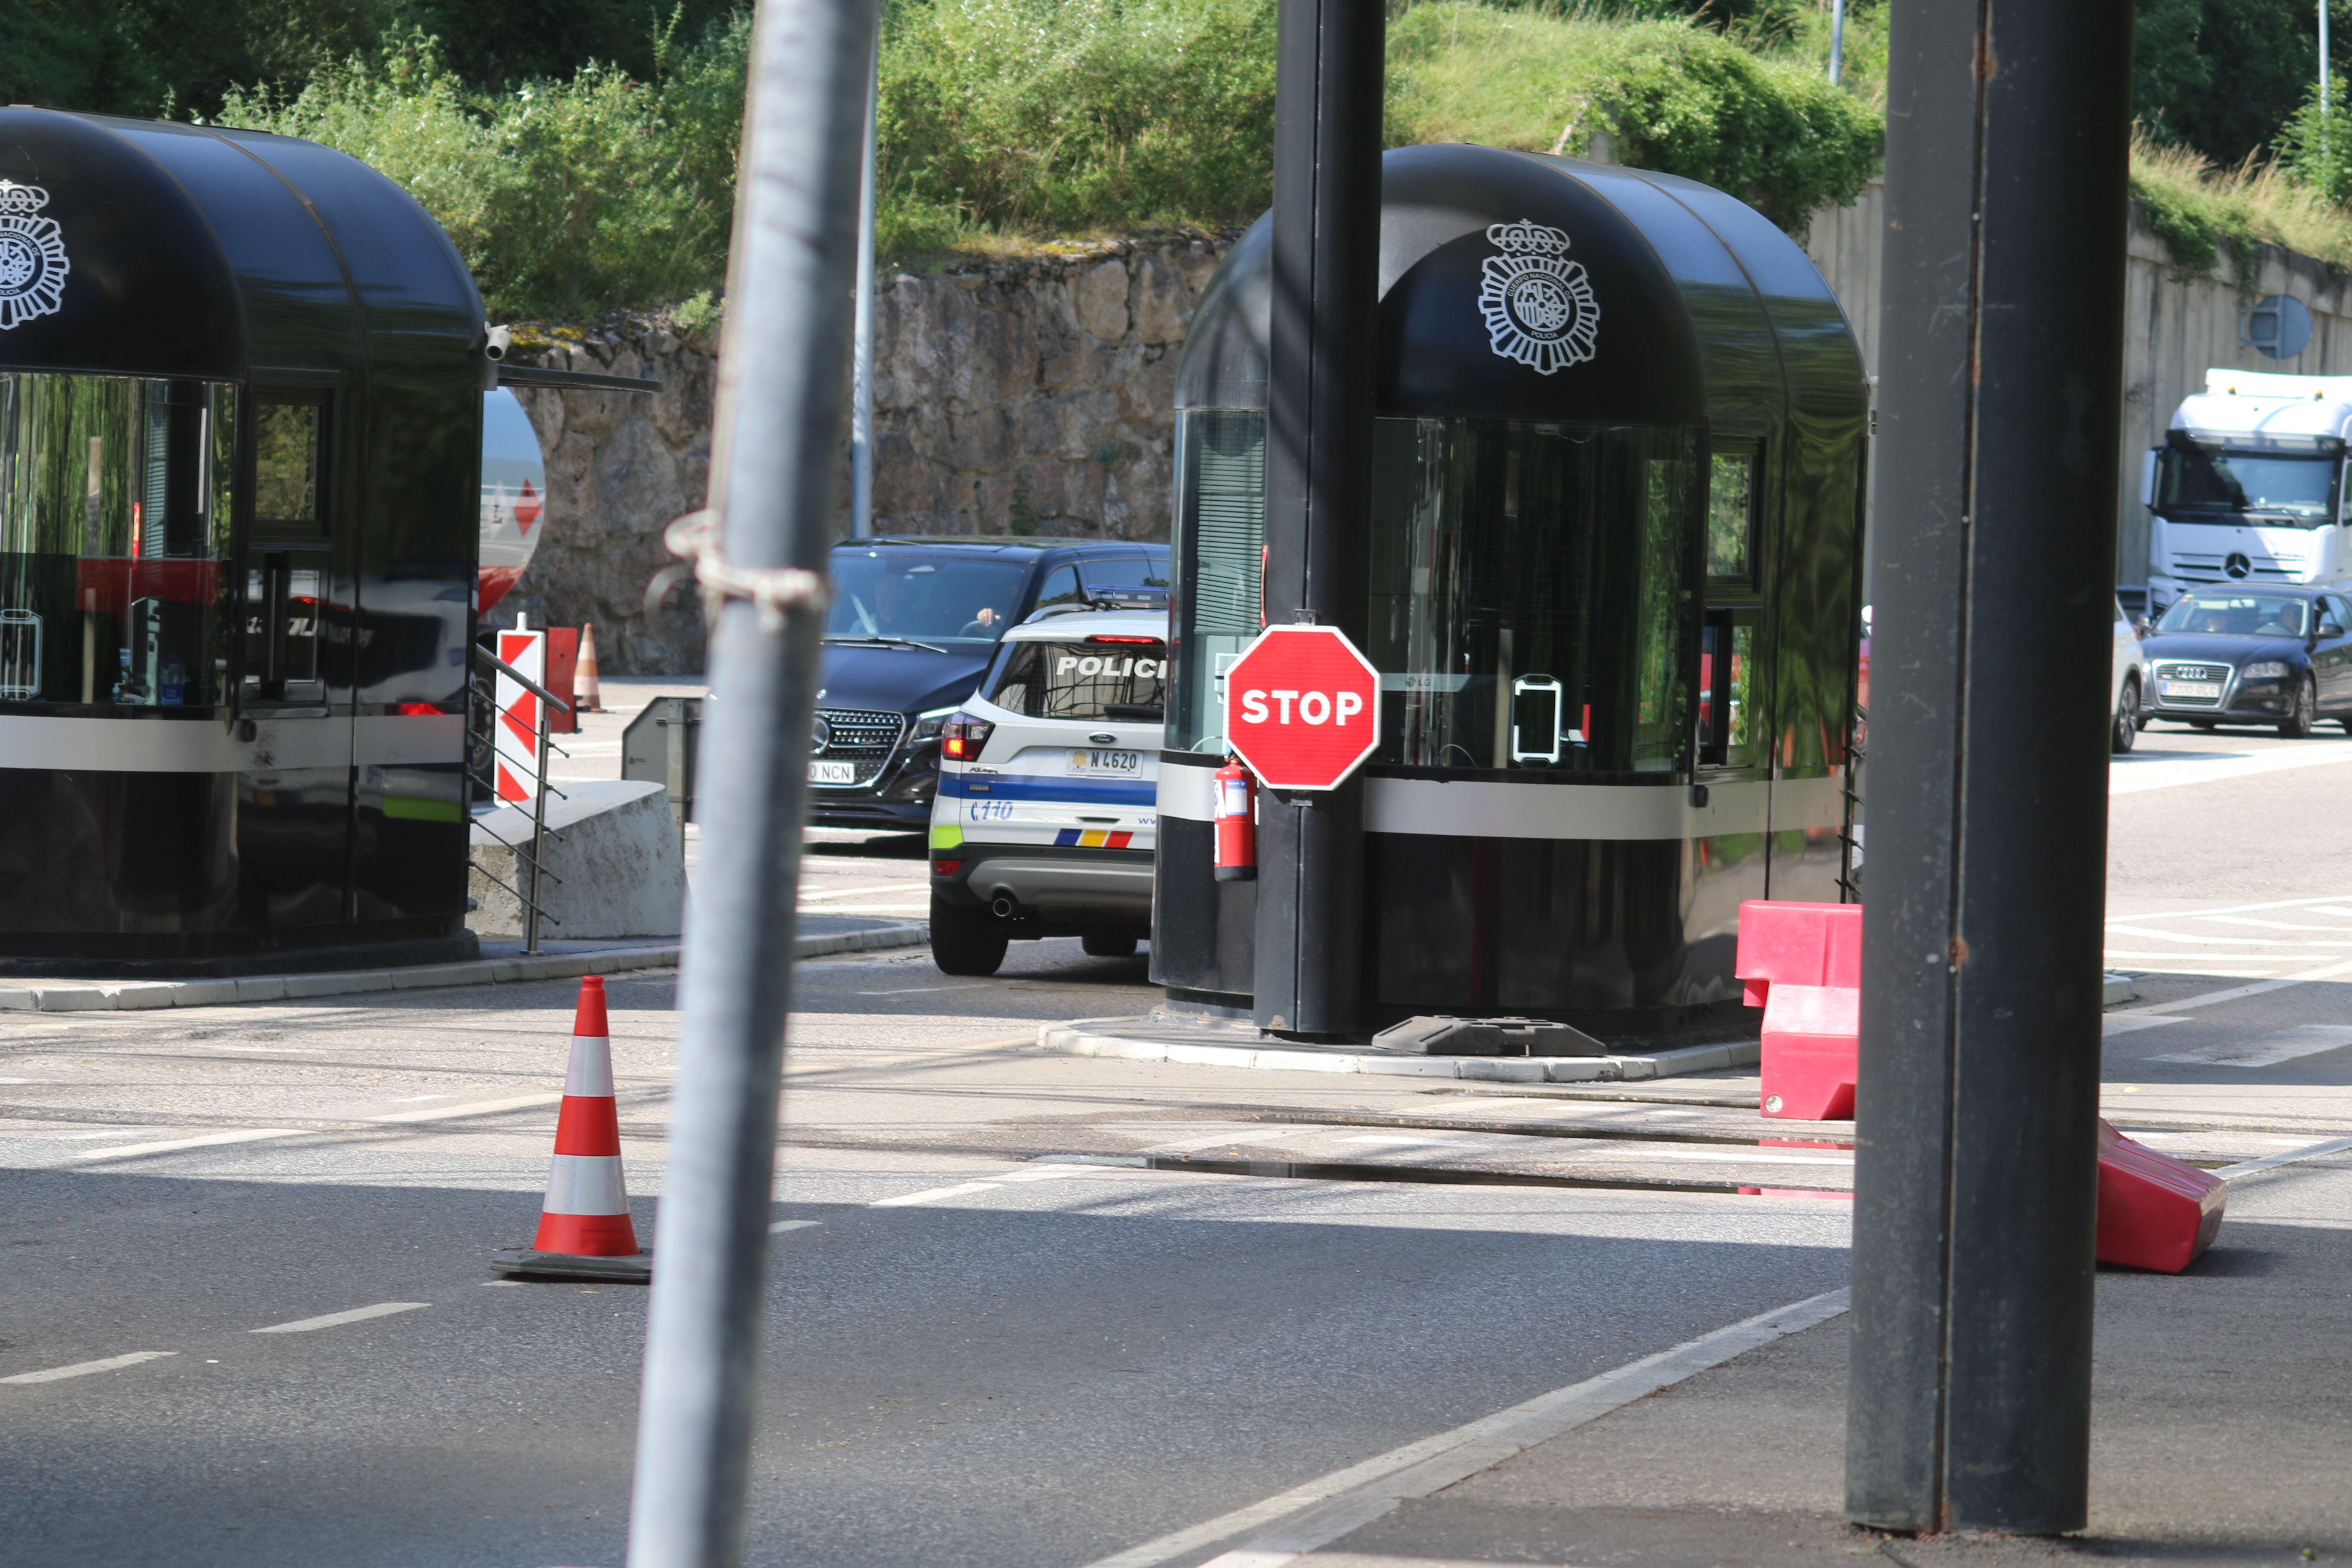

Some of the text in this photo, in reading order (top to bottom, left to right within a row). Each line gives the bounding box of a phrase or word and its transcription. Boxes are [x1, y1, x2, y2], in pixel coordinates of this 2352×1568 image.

[31, 247, 41, 257] DE
[1507, 273, 1573, 300] CUERPO NACIONAL DE
[2170, 684, 2193, 694] 7200
[1240, 689, 1363, 726] STOP
[1091, 752, 1137, 769] N 4620
[822, 766, 850, 779] NCN
[981, 801, 1013, 821] 110
